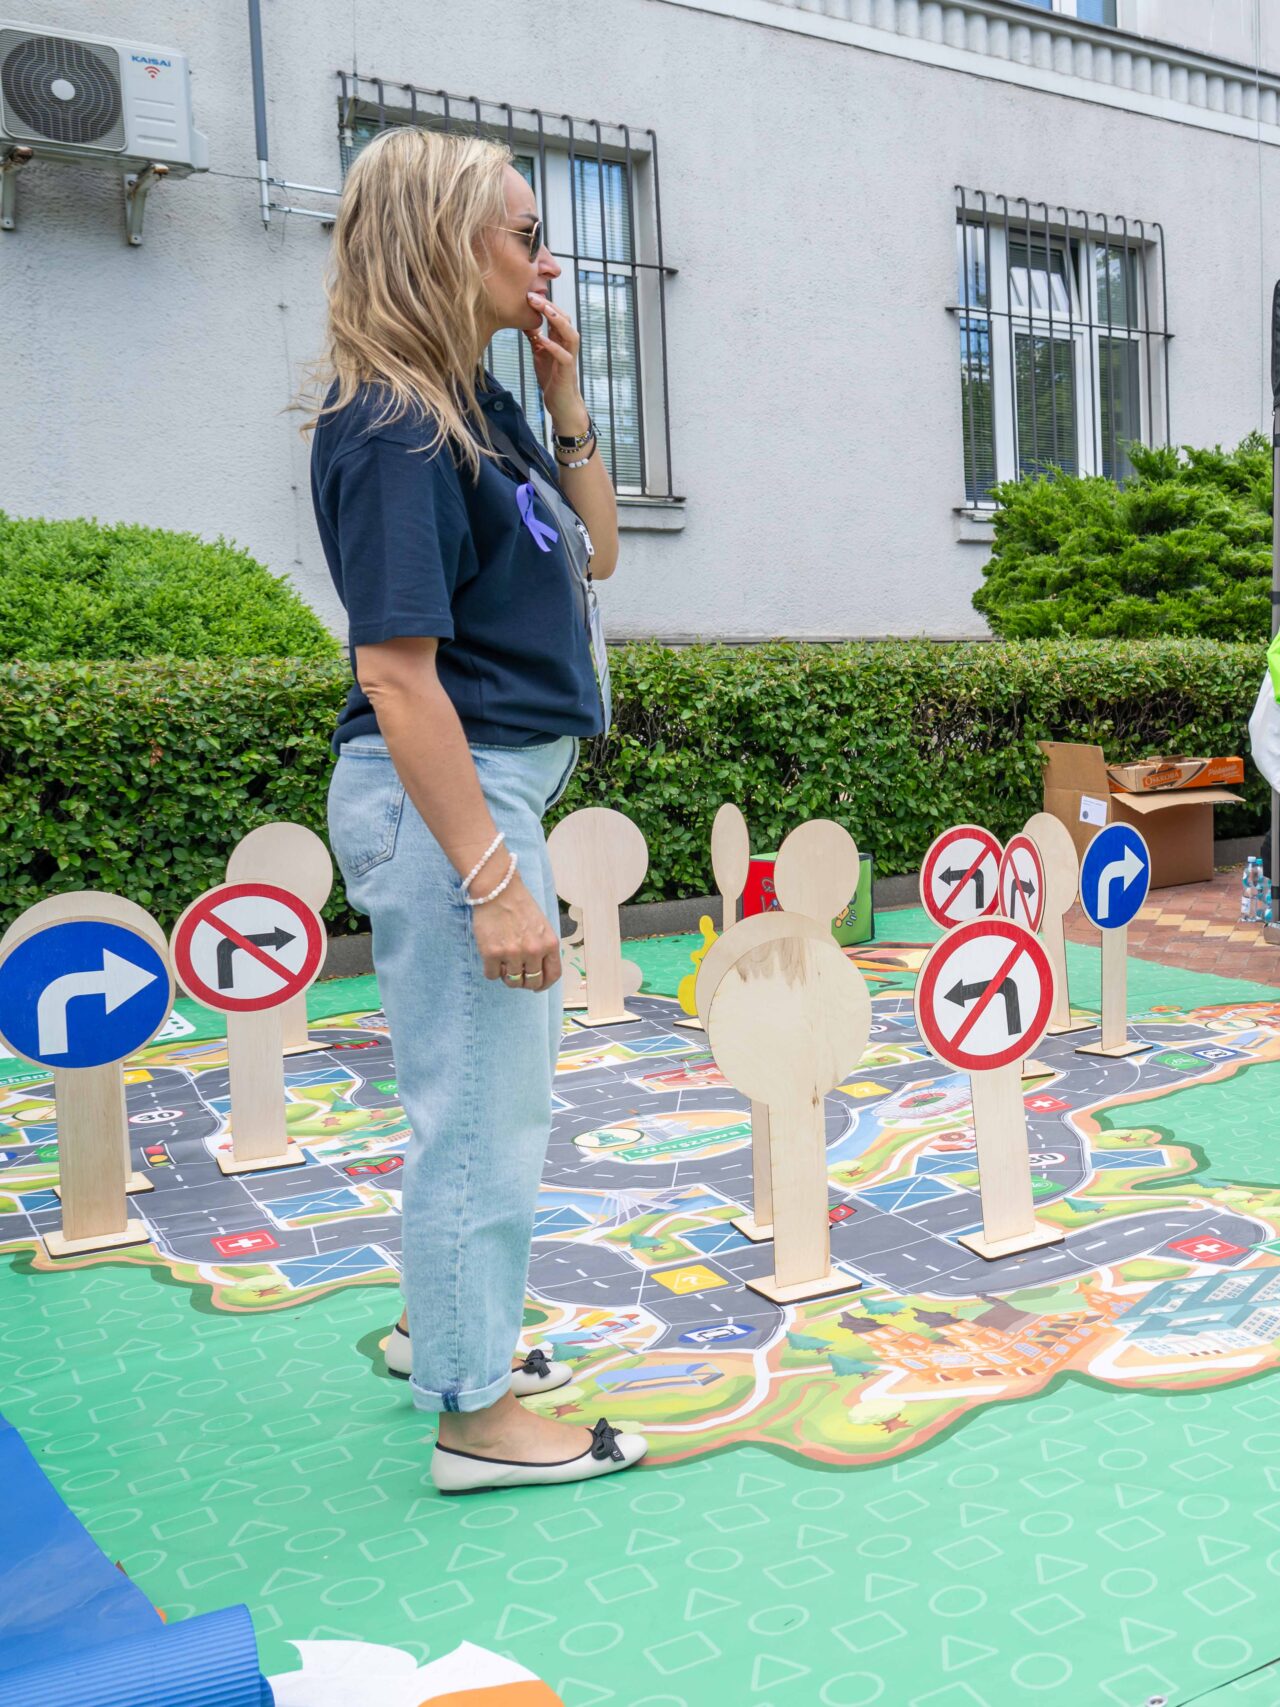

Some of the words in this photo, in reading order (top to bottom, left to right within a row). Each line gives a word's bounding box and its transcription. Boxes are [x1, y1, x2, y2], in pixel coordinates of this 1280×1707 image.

[131, 55, 171, 68] KAISAI
[138, 1111, 174, 1122] 30
[634, 1130, 741, 1153] Warszawa
